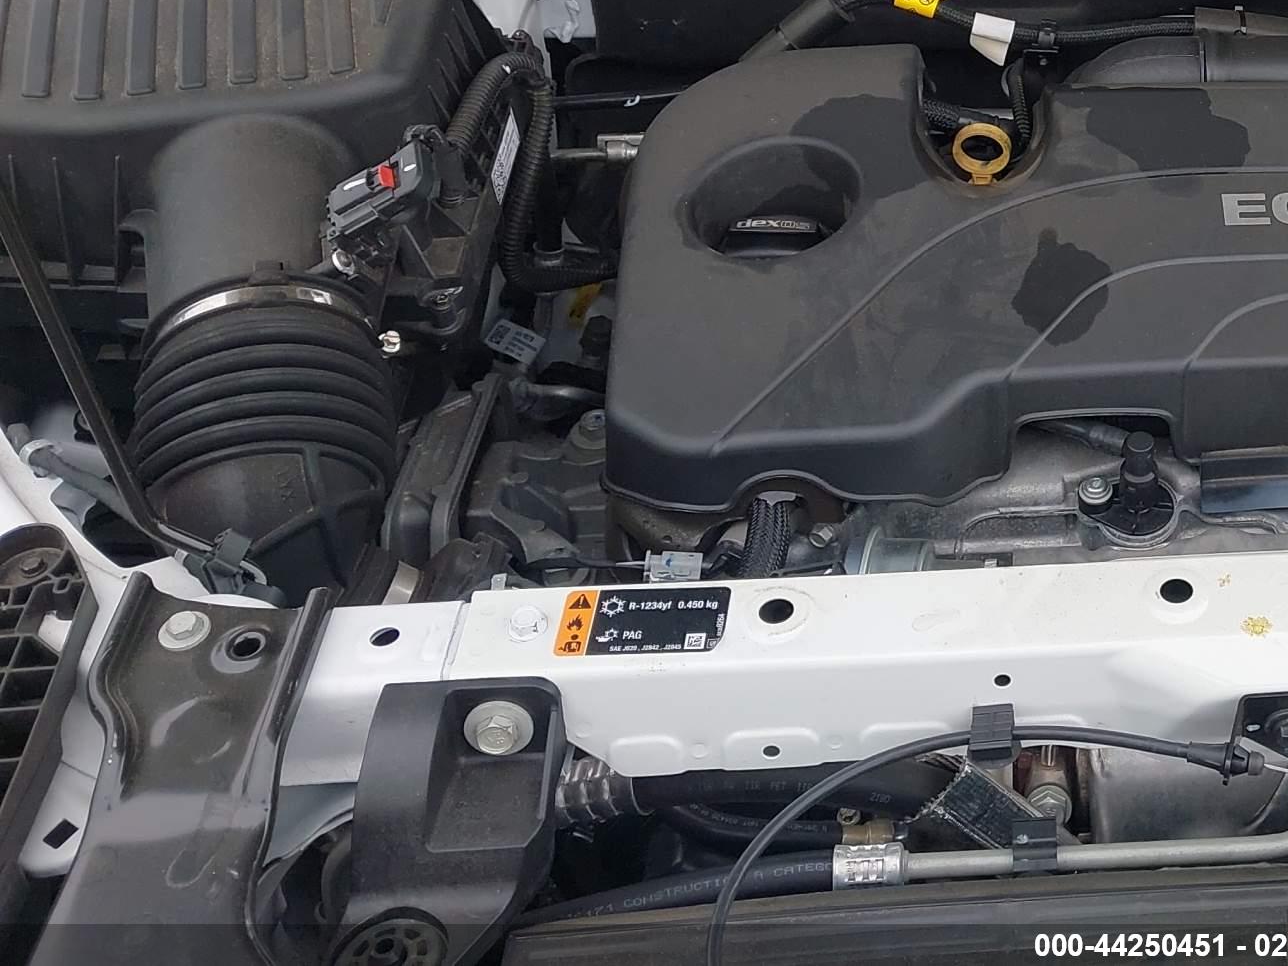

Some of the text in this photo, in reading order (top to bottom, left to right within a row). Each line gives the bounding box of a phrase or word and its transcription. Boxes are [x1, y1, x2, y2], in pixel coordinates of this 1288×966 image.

[736, 218, 810, 230] dexos
[628, 600, 719, 611] R-1234yf 0.450 kg
[622, 630, 643, 640] PAG
